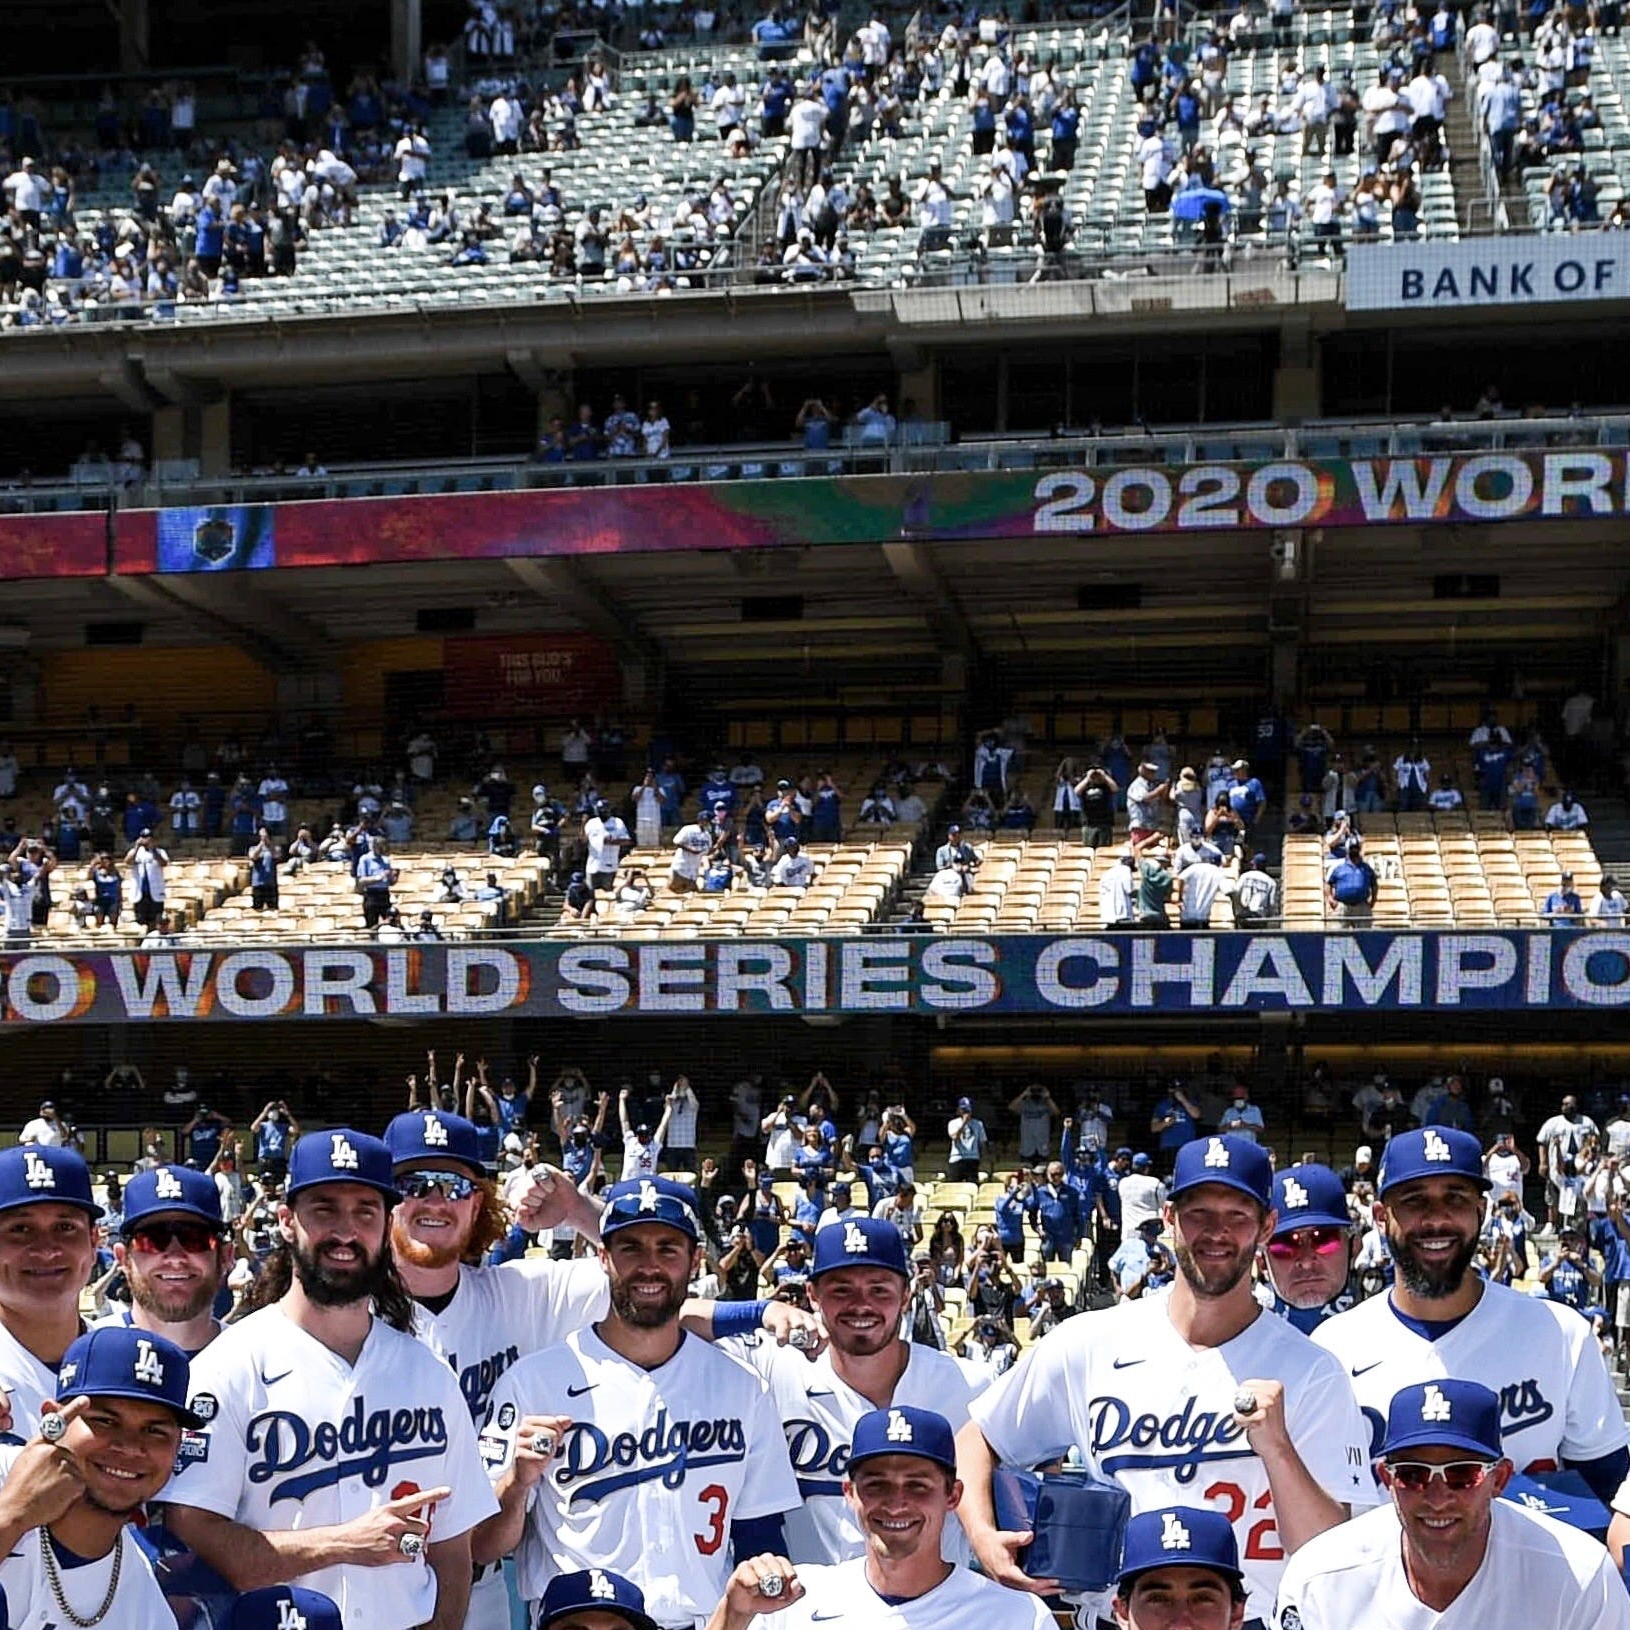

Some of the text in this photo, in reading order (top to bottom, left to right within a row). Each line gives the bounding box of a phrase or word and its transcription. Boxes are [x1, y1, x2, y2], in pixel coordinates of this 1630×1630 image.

[1401, 262, 1535, 300] BANK
[1554, 258, 1616, 294] OF
[1034, 465, 1321, 533] 2020
[112, 947, 522, 1018] WORLD
[557, 940, 999, 1012] SERIES
[424, 1115, 447, 1145] LA
[1424, 1131, 1450, 1160] LA
[331, 1135, 357, 1168] LA
[1205, 1138, 1229, 1167] LA
[24, 1153, 55, 1187] LA
[156, 1169, 182, 1197] LA
[1283, 1178, 1308, 1208] LA
[844, 1223, 867, 1252] LA
[135, 1335, 167, 1384] LA
[1419, 1381, 1450, 1420] LA
[887, 1410, 912, 1441] LA
[1088, 1394, 1246, 1484] Dodge
[246, 1396, 448, 1494] Dodgers
[556, 1408, 745, 1496] Dodgers
[1345, 1446, 1363, 1465] VII
[695, 1484, 730, 1556] 3
[1161, 1514, 1190, 1549] LA
[585, 1565, 620, 1599] LA
